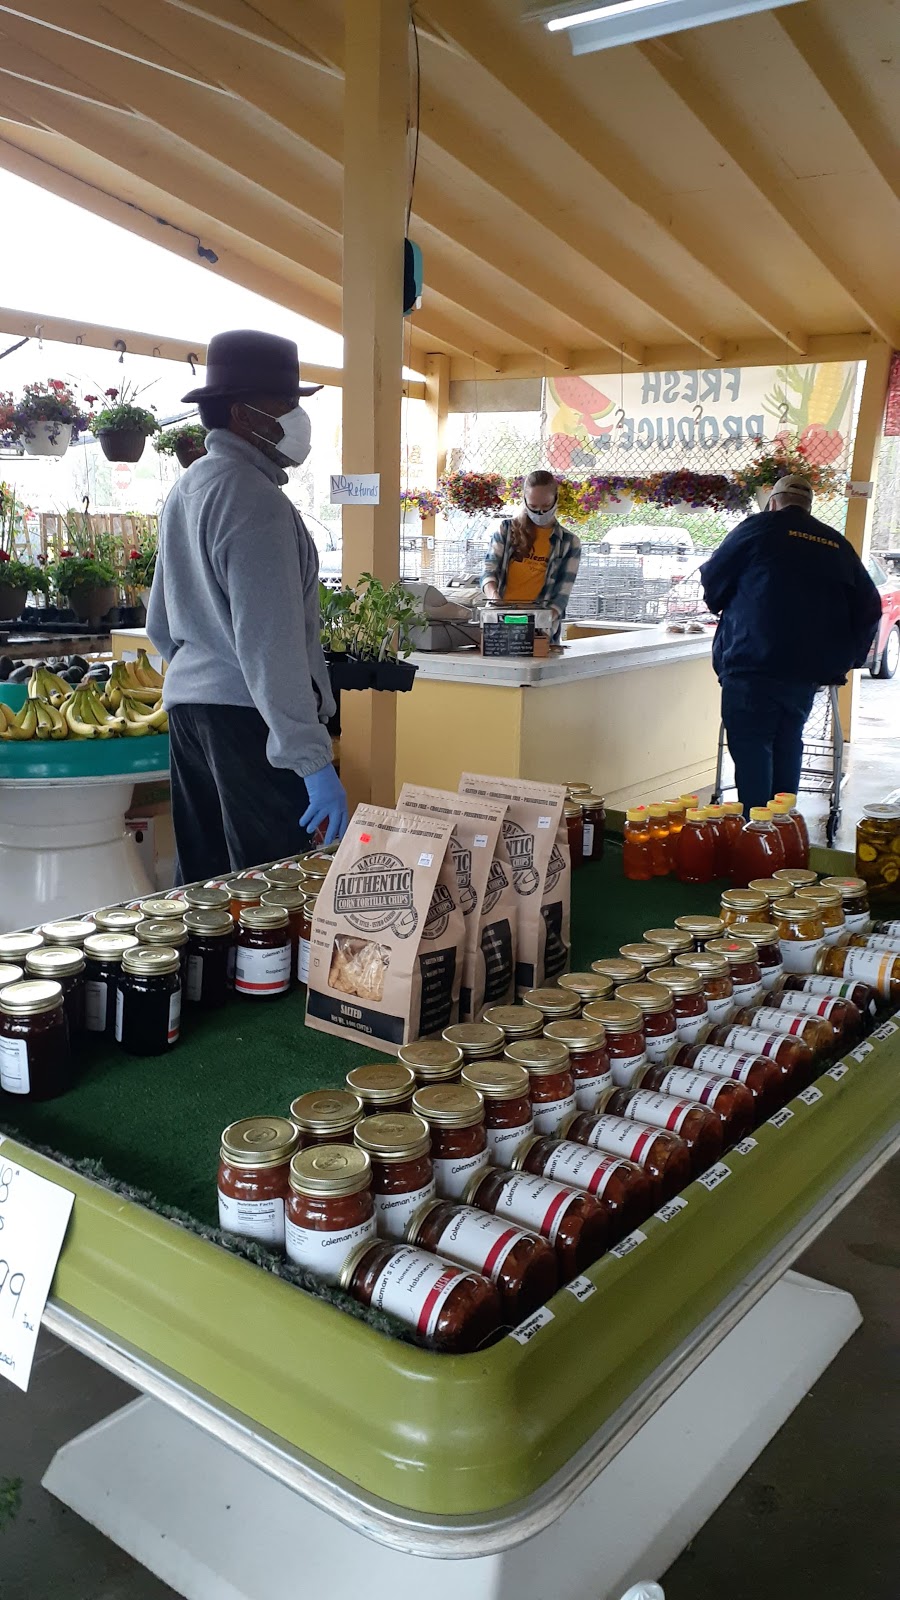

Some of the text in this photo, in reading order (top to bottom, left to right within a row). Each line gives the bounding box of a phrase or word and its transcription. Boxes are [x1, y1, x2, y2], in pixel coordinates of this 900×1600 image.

[788, 530, 840, 549] MICHIGAN
[357, 856, 396, 871] HACIENDA
[338, 872, 410, 895] AUTHENTIC
[338, 894, 409, 908] CORN TORTILLA CHIPS
[340, 1004, 362, 1019] SALTED
[494, 1129, 524, 1143] Coleman's
[572, 1161, 583, 1175] Mild
[380, 1194, 416, 1211] Coleman's
[450, 1212, 471, 1241] Coleman's
[321, 1230, 359, 1247] Coleman's
[389, 1253, 407, 1269] Farm
[407, 1262, 434, 1293] Habanero
